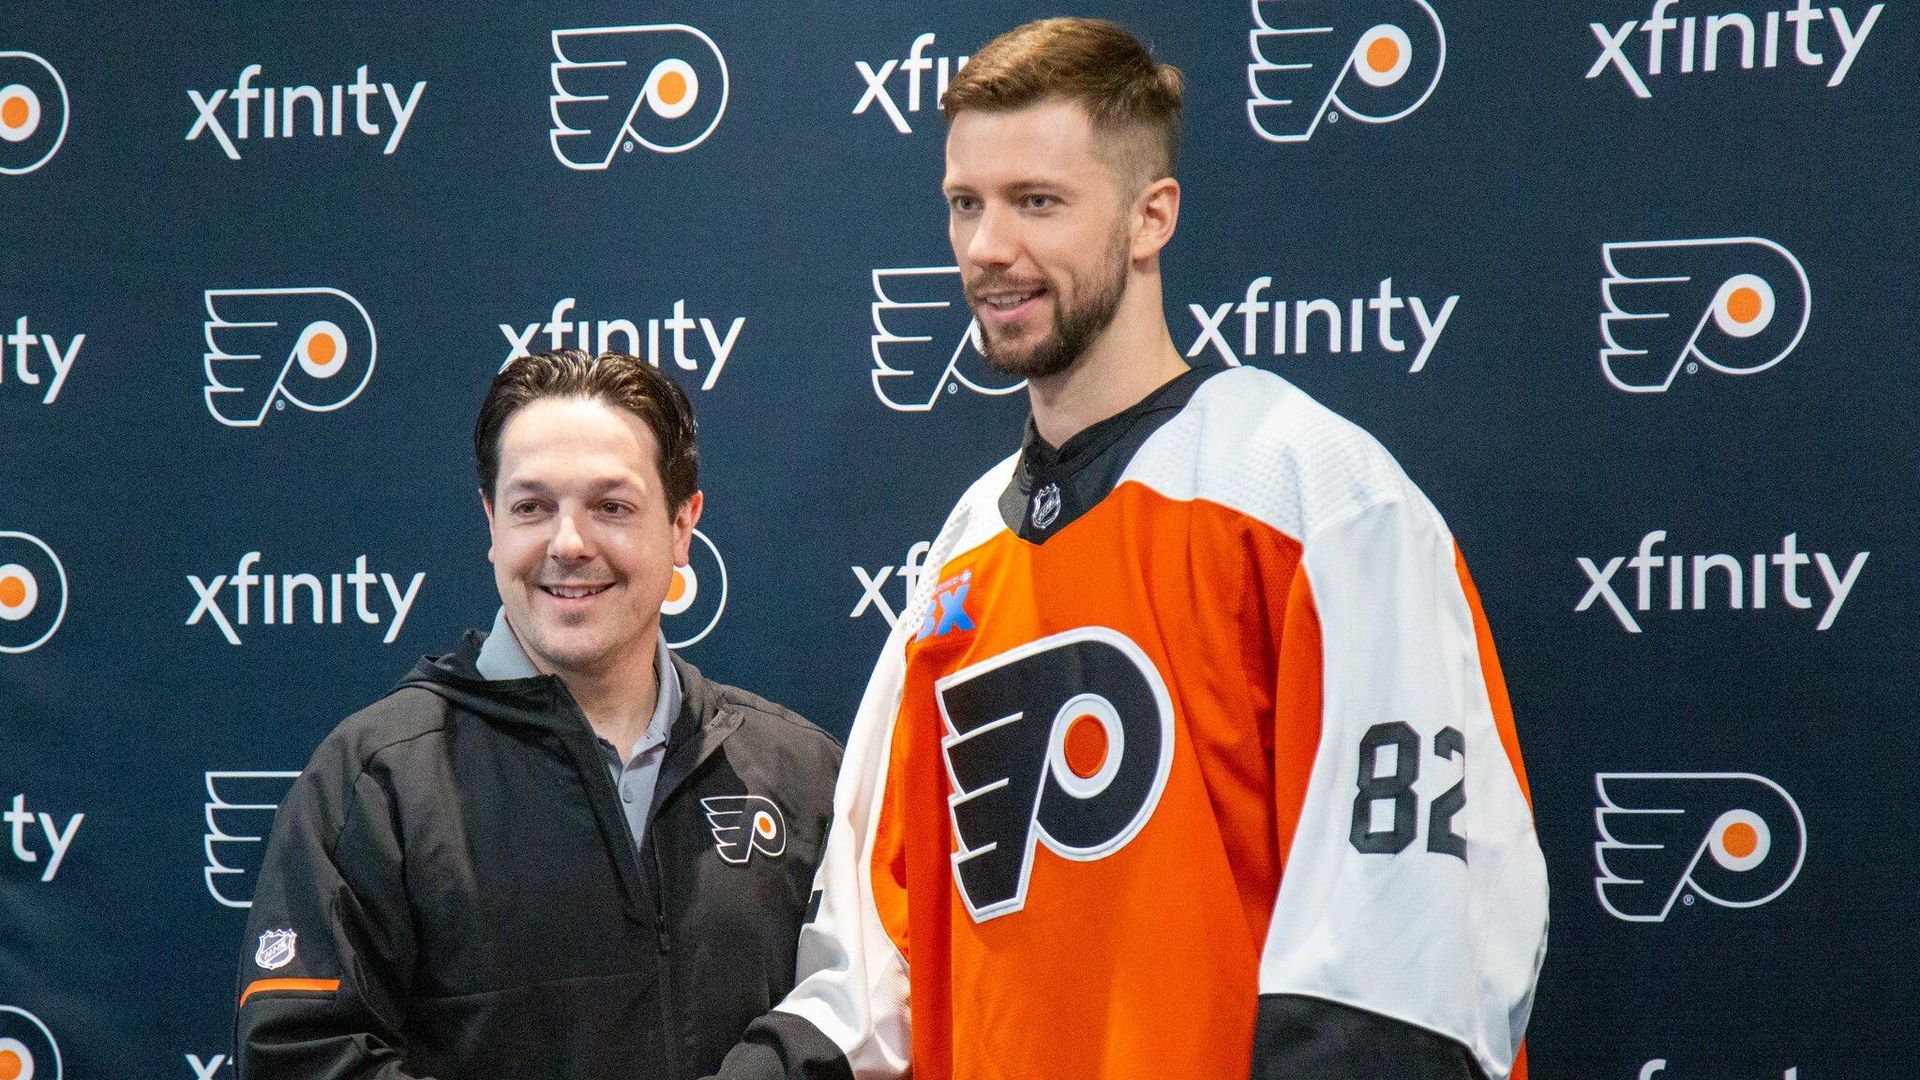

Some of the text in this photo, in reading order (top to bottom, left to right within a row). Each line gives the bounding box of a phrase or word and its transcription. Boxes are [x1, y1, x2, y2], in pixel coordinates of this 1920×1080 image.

[1585, 0, 1885, 99] xfinity
[186, 64, 427, 160] xfinity
[498, 297, 746, 391] xfinity
[1186, 276, 1460, 373] xfinity
[186, 552, 426, 645] xfinity
[1574, 530, 1870, 633] xfinity
[1349, 721, 1468, 868] 82
